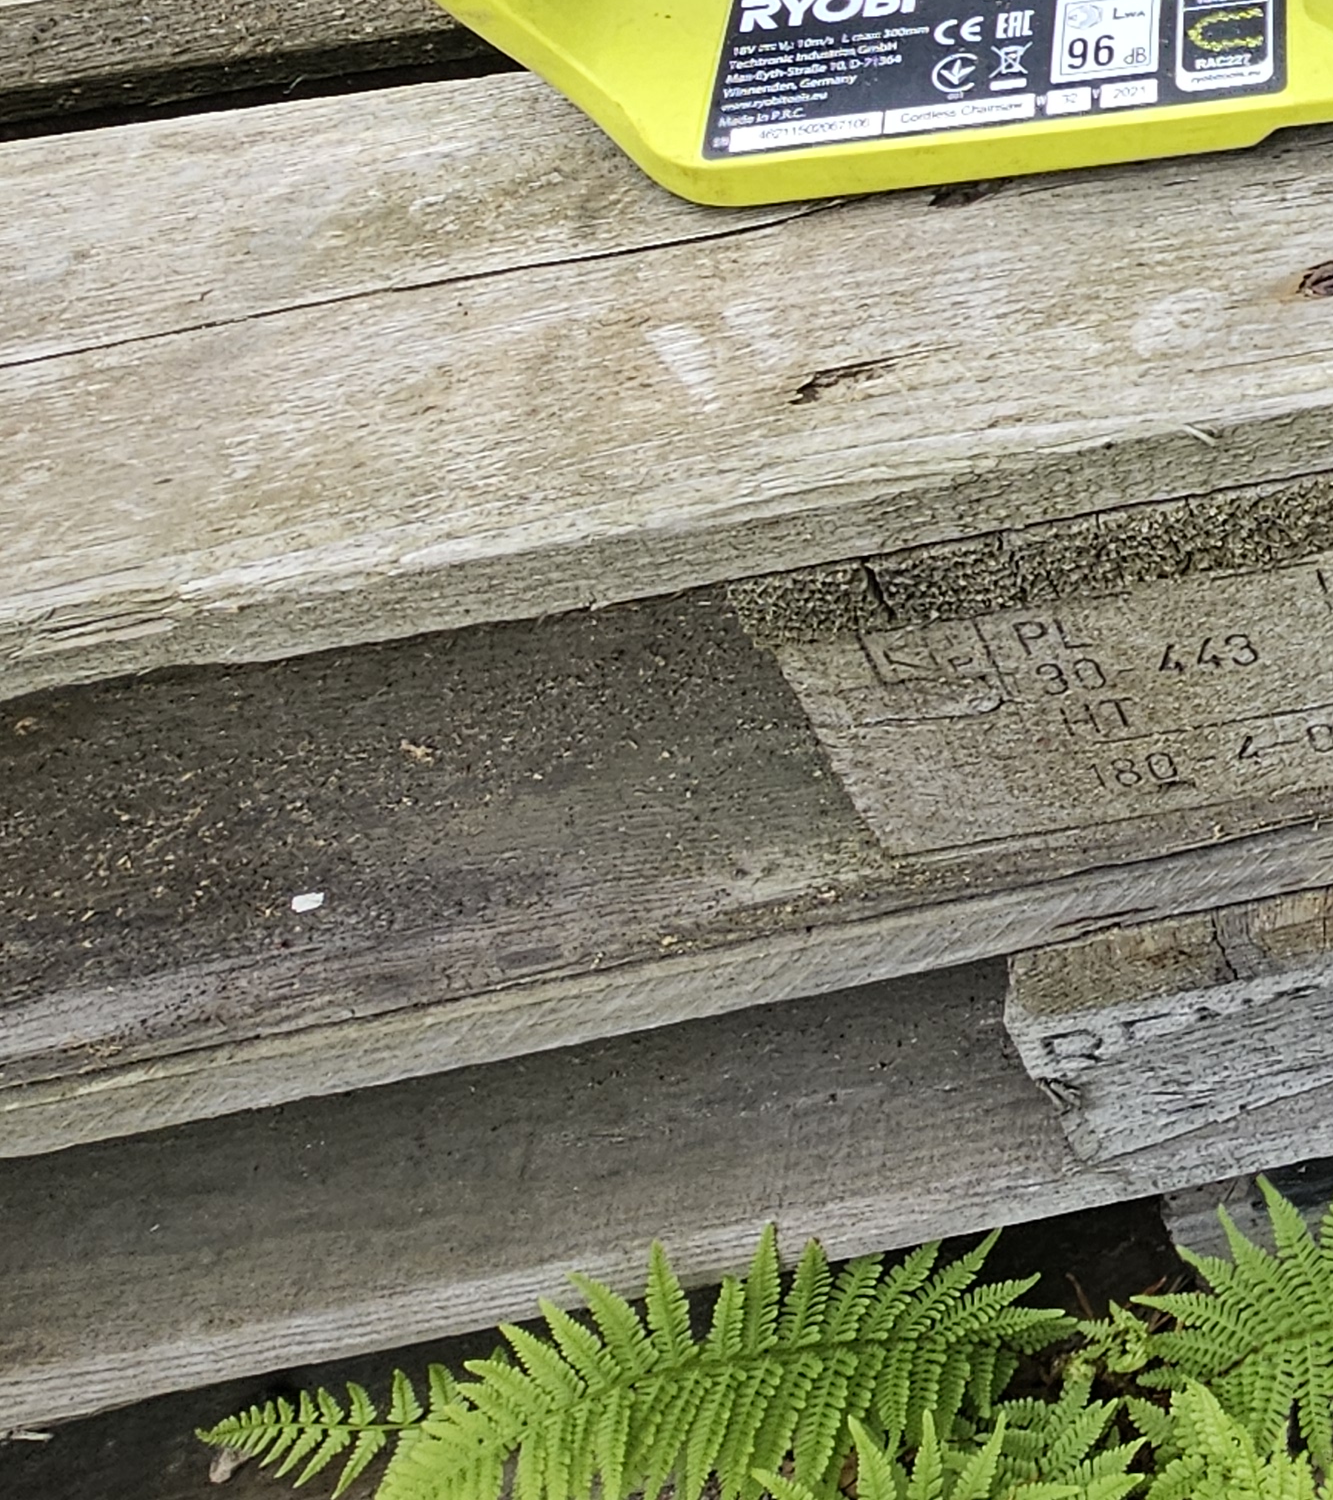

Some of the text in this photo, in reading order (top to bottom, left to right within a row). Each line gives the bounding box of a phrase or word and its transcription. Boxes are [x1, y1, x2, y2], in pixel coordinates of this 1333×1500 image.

[933, 15, 984, 45] CE
[729, 54, 793, 70] Techtronic
[858, 41, 898, 55] GmbH
[1067, 34, 1147, 71] 96 dB
[800, 74, 857, 90] Germany
[718, 113, 754, 128] Made
